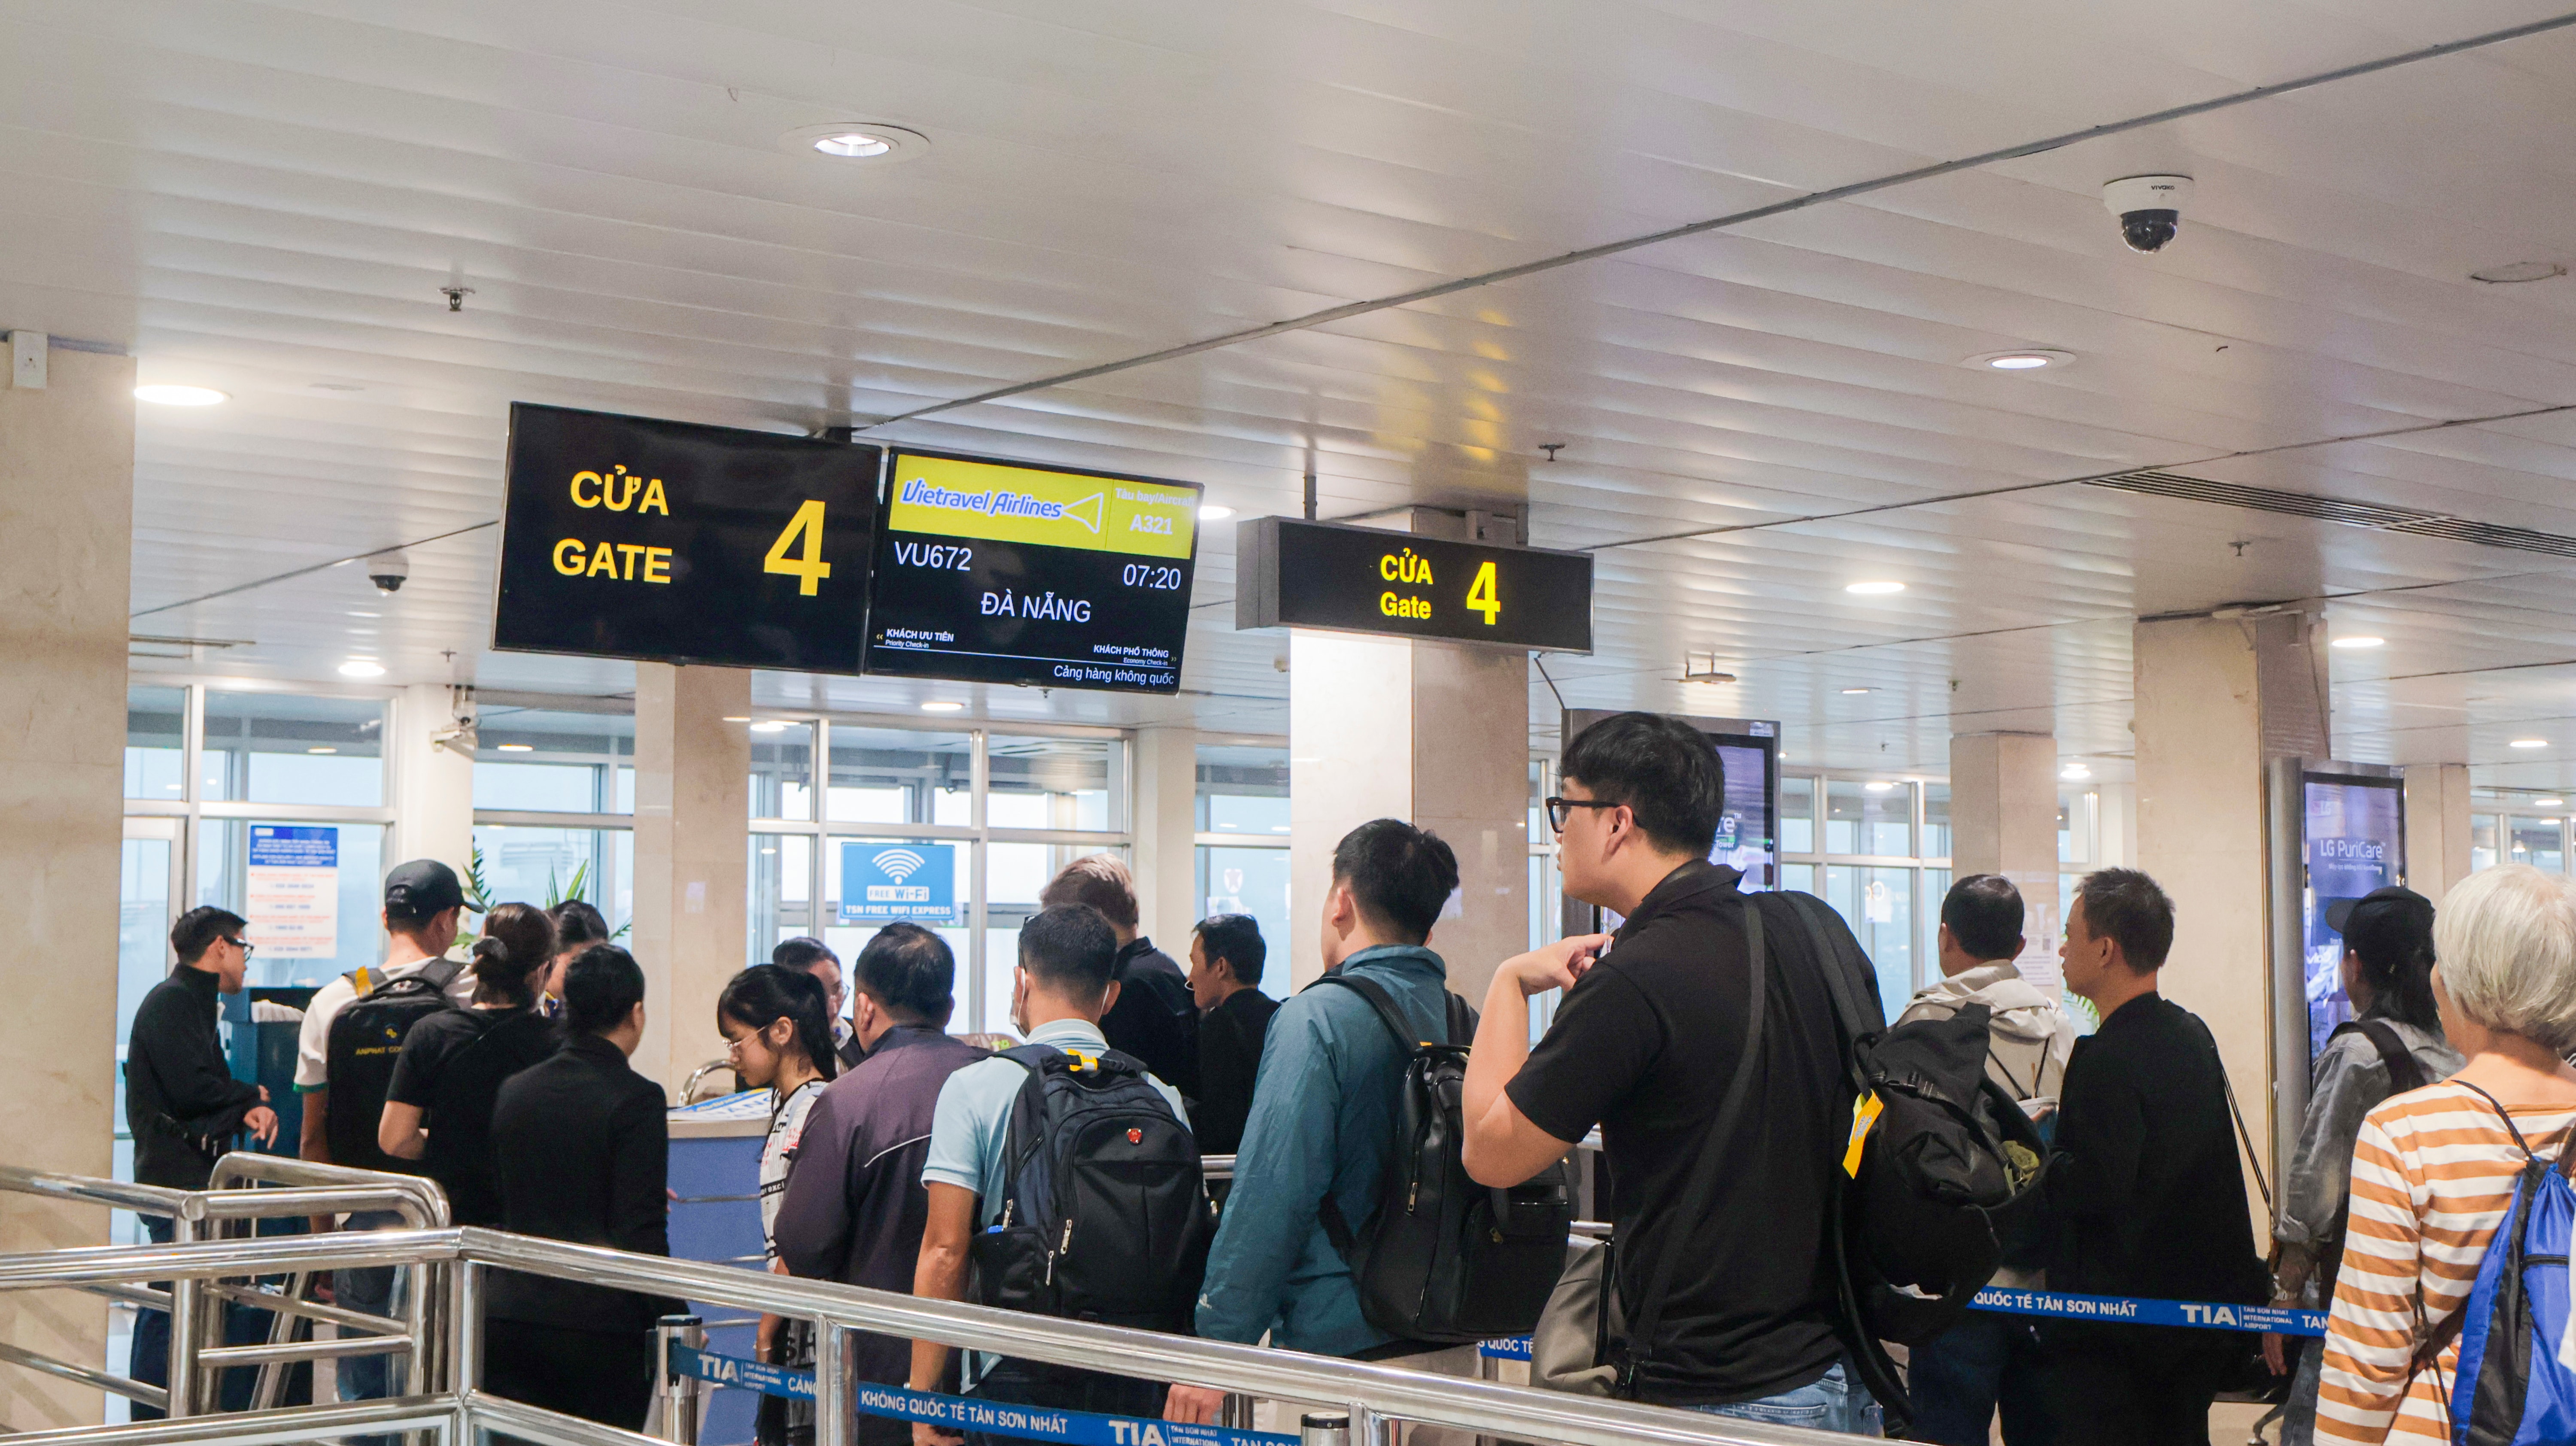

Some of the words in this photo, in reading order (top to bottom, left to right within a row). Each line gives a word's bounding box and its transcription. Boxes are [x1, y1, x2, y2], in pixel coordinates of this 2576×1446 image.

[570, 465, 669, 516] CỬA
[901, 480, 988, 510] Vietravel
[990, 492, 1063, 518] Airlines
[1130, 514, 1173, 535] A321
[553, 538, 672, 584] GATE
[763, 500, 831, 596] 4
[894, 541, 972, 571] VU672
[1123, 563, 1182, 590] 07:20
[1380, 547, 1434, 585] CỬA
[981, 589, 1015, 617] ĐÀ
[1022, 592, 1091, 623] NẴNG
[1380, 592, 1432, 620] Gate
[1466, 561, 1501, 626] 4
[885, 639, 905, 647] Priority
[887, 628, 918, 639] KHÁCH
[919, 631, 933, 640] ƯU
[934, 631, 954, 642] TIÊN
[1094, 644, 1121, 654] KHÁCH
[1142, 647, 1169, 658] THÔNG
[1123, 657, 1146, 665] Economy
[1054, 665, 1083, 681] Cảng
[1085, 667, 1112, 683] hàng
[1115, 669, 1146, 685] không
[1149, 672, 1175, 686] quốc
[2320, 839, 2335, 857] LG
[2338, 840, 2383, 859] PuriCare
[895, 888, 927, 900] Wi-Fi
[845, 905, 864, 914] TSN
[866, 905, 888, 914] FREE
[912, 906, 951, 915] EXPRESS
[1974, 1291, 2012, 1307] QUỐC
[2015, 1293, 2033, 1309] TẾ
[2035, 1296, 2063, 1311] TÂN
[2066, 1300, 2096, 1314] SƠN
[2099, 1300, 2138, 1317] NHẤT
[2180, 1304, 2237, 1326] TIA
[2243, 1314, 2293, 1324] INTERNATIONAL
[698, 1354, 739, 1382] TIA
[744, 1371, 781, 1385] INTERNATIONAL
[861, 1390, 905, 1412] KHÔNG
[909, 1397, 946, 1418] QUỐC
[949, 1401, 966, 1421] TẾ
[968, 1404, 994, 1425] TÂN
[998, 1410, 1027, 1428] SƠN
[1030, 1413, 1068, 1434] NHẤT
[1108, 1420, 1166, 1446] TIA
